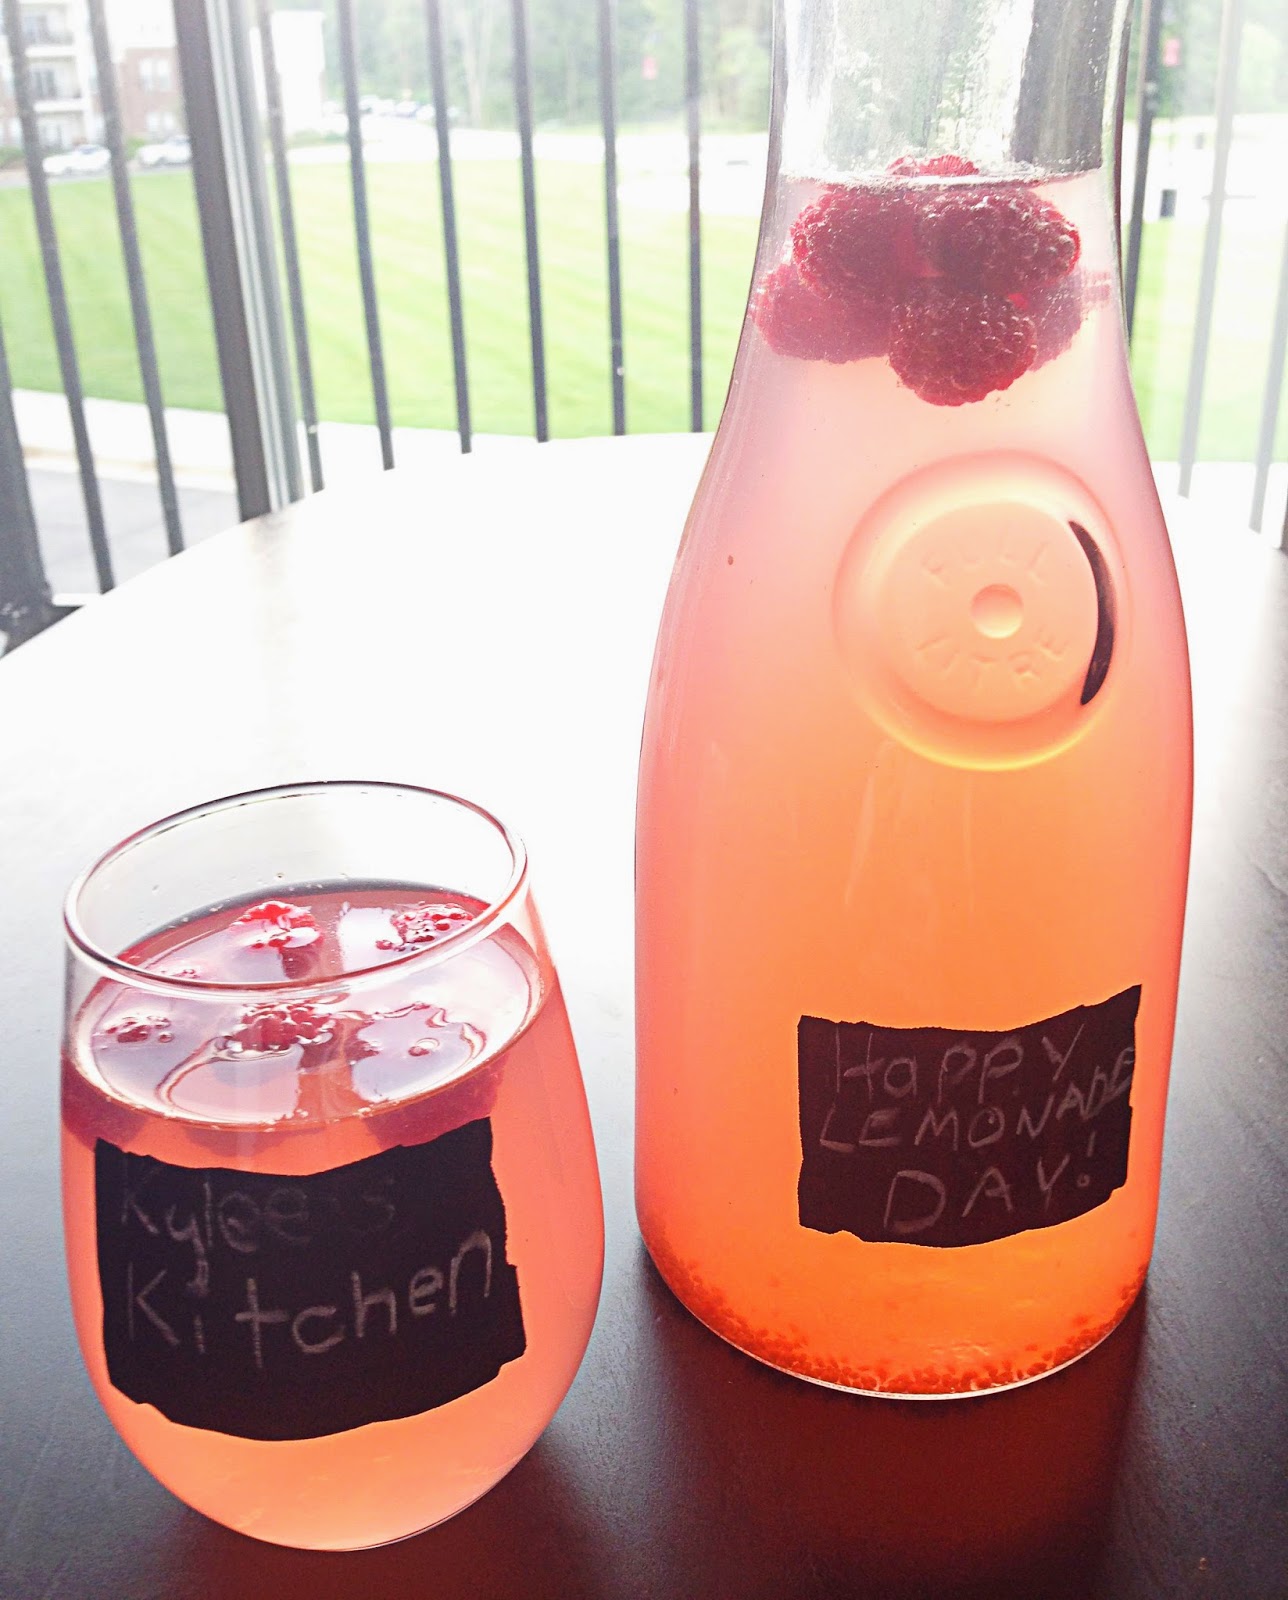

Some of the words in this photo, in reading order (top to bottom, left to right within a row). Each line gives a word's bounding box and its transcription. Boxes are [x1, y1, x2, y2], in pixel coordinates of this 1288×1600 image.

[819, 1046, 1136, 1153] LEMONADE
[883, 1130, 1097, 1235] DAY!
[127, 1228, 493, 1369] Kitchen
